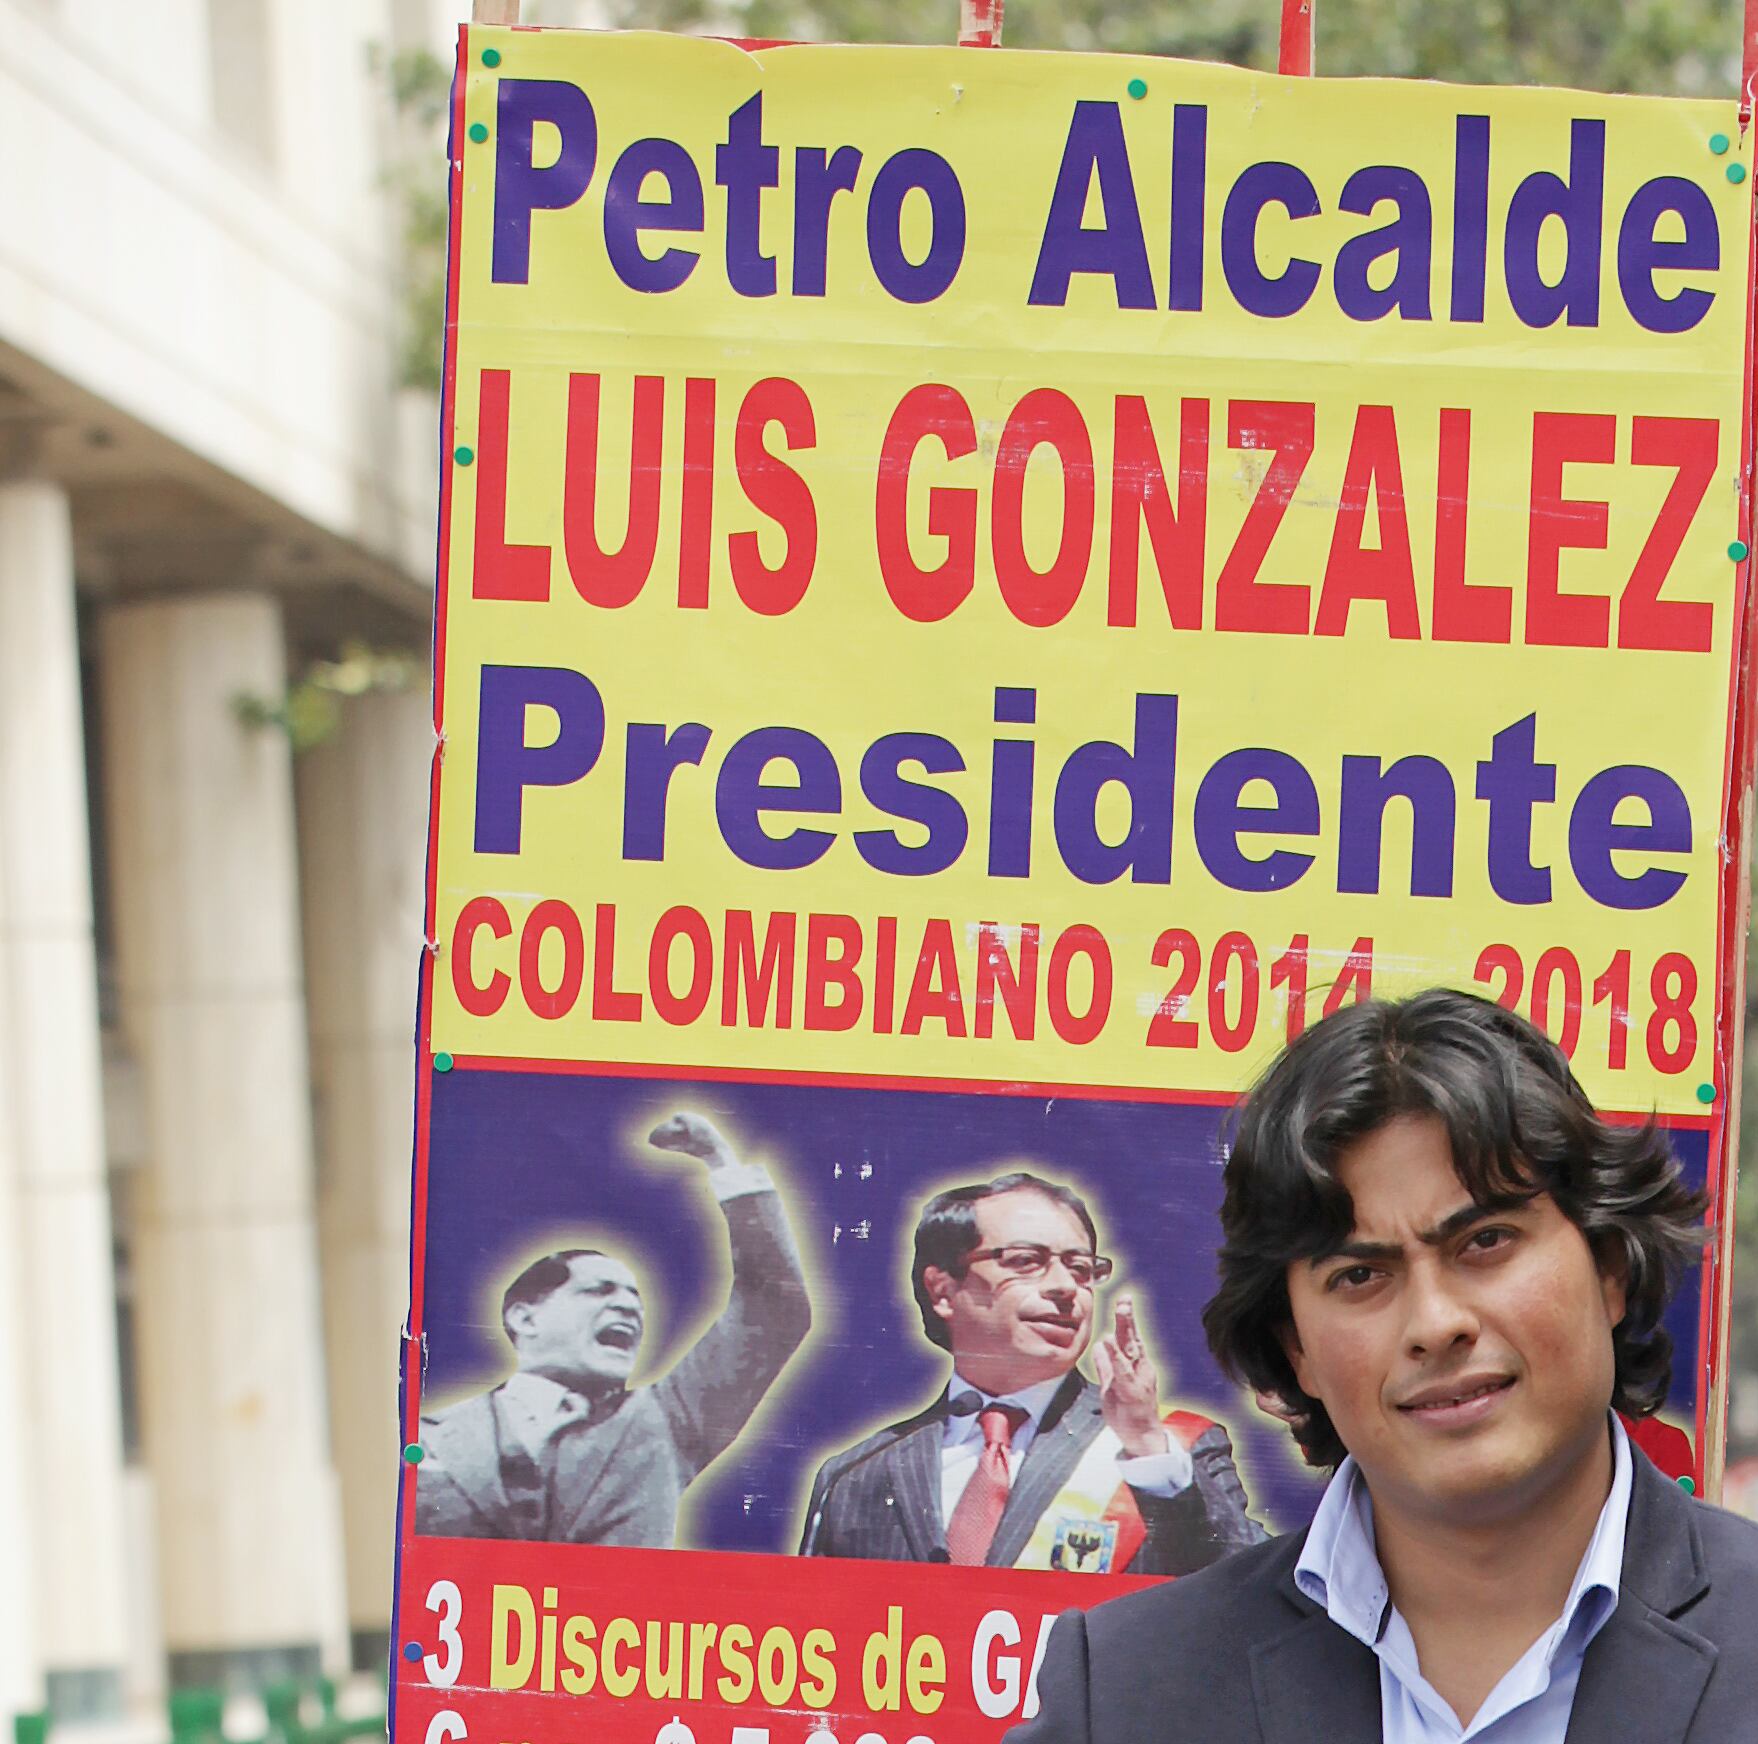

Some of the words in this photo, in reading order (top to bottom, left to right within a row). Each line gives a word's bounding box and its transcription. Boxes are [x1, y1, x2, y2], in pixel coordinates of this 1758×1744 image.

[492, 78, 967, 303] Petro
[1028, 101, 1721, 332] Alcalde
[471, 368, 818, 617] LUIS
[875, 383, 1721, 654] GONZALEZ
[473, 664, 1693, 909] Presidente
[450, 896, 1114, 1047] COLOMBIANO
[423, 1580, 464, 1690] 3
[489, 1584, 838, 1709] Discursos
[862, 1605, 948, 1715] de
